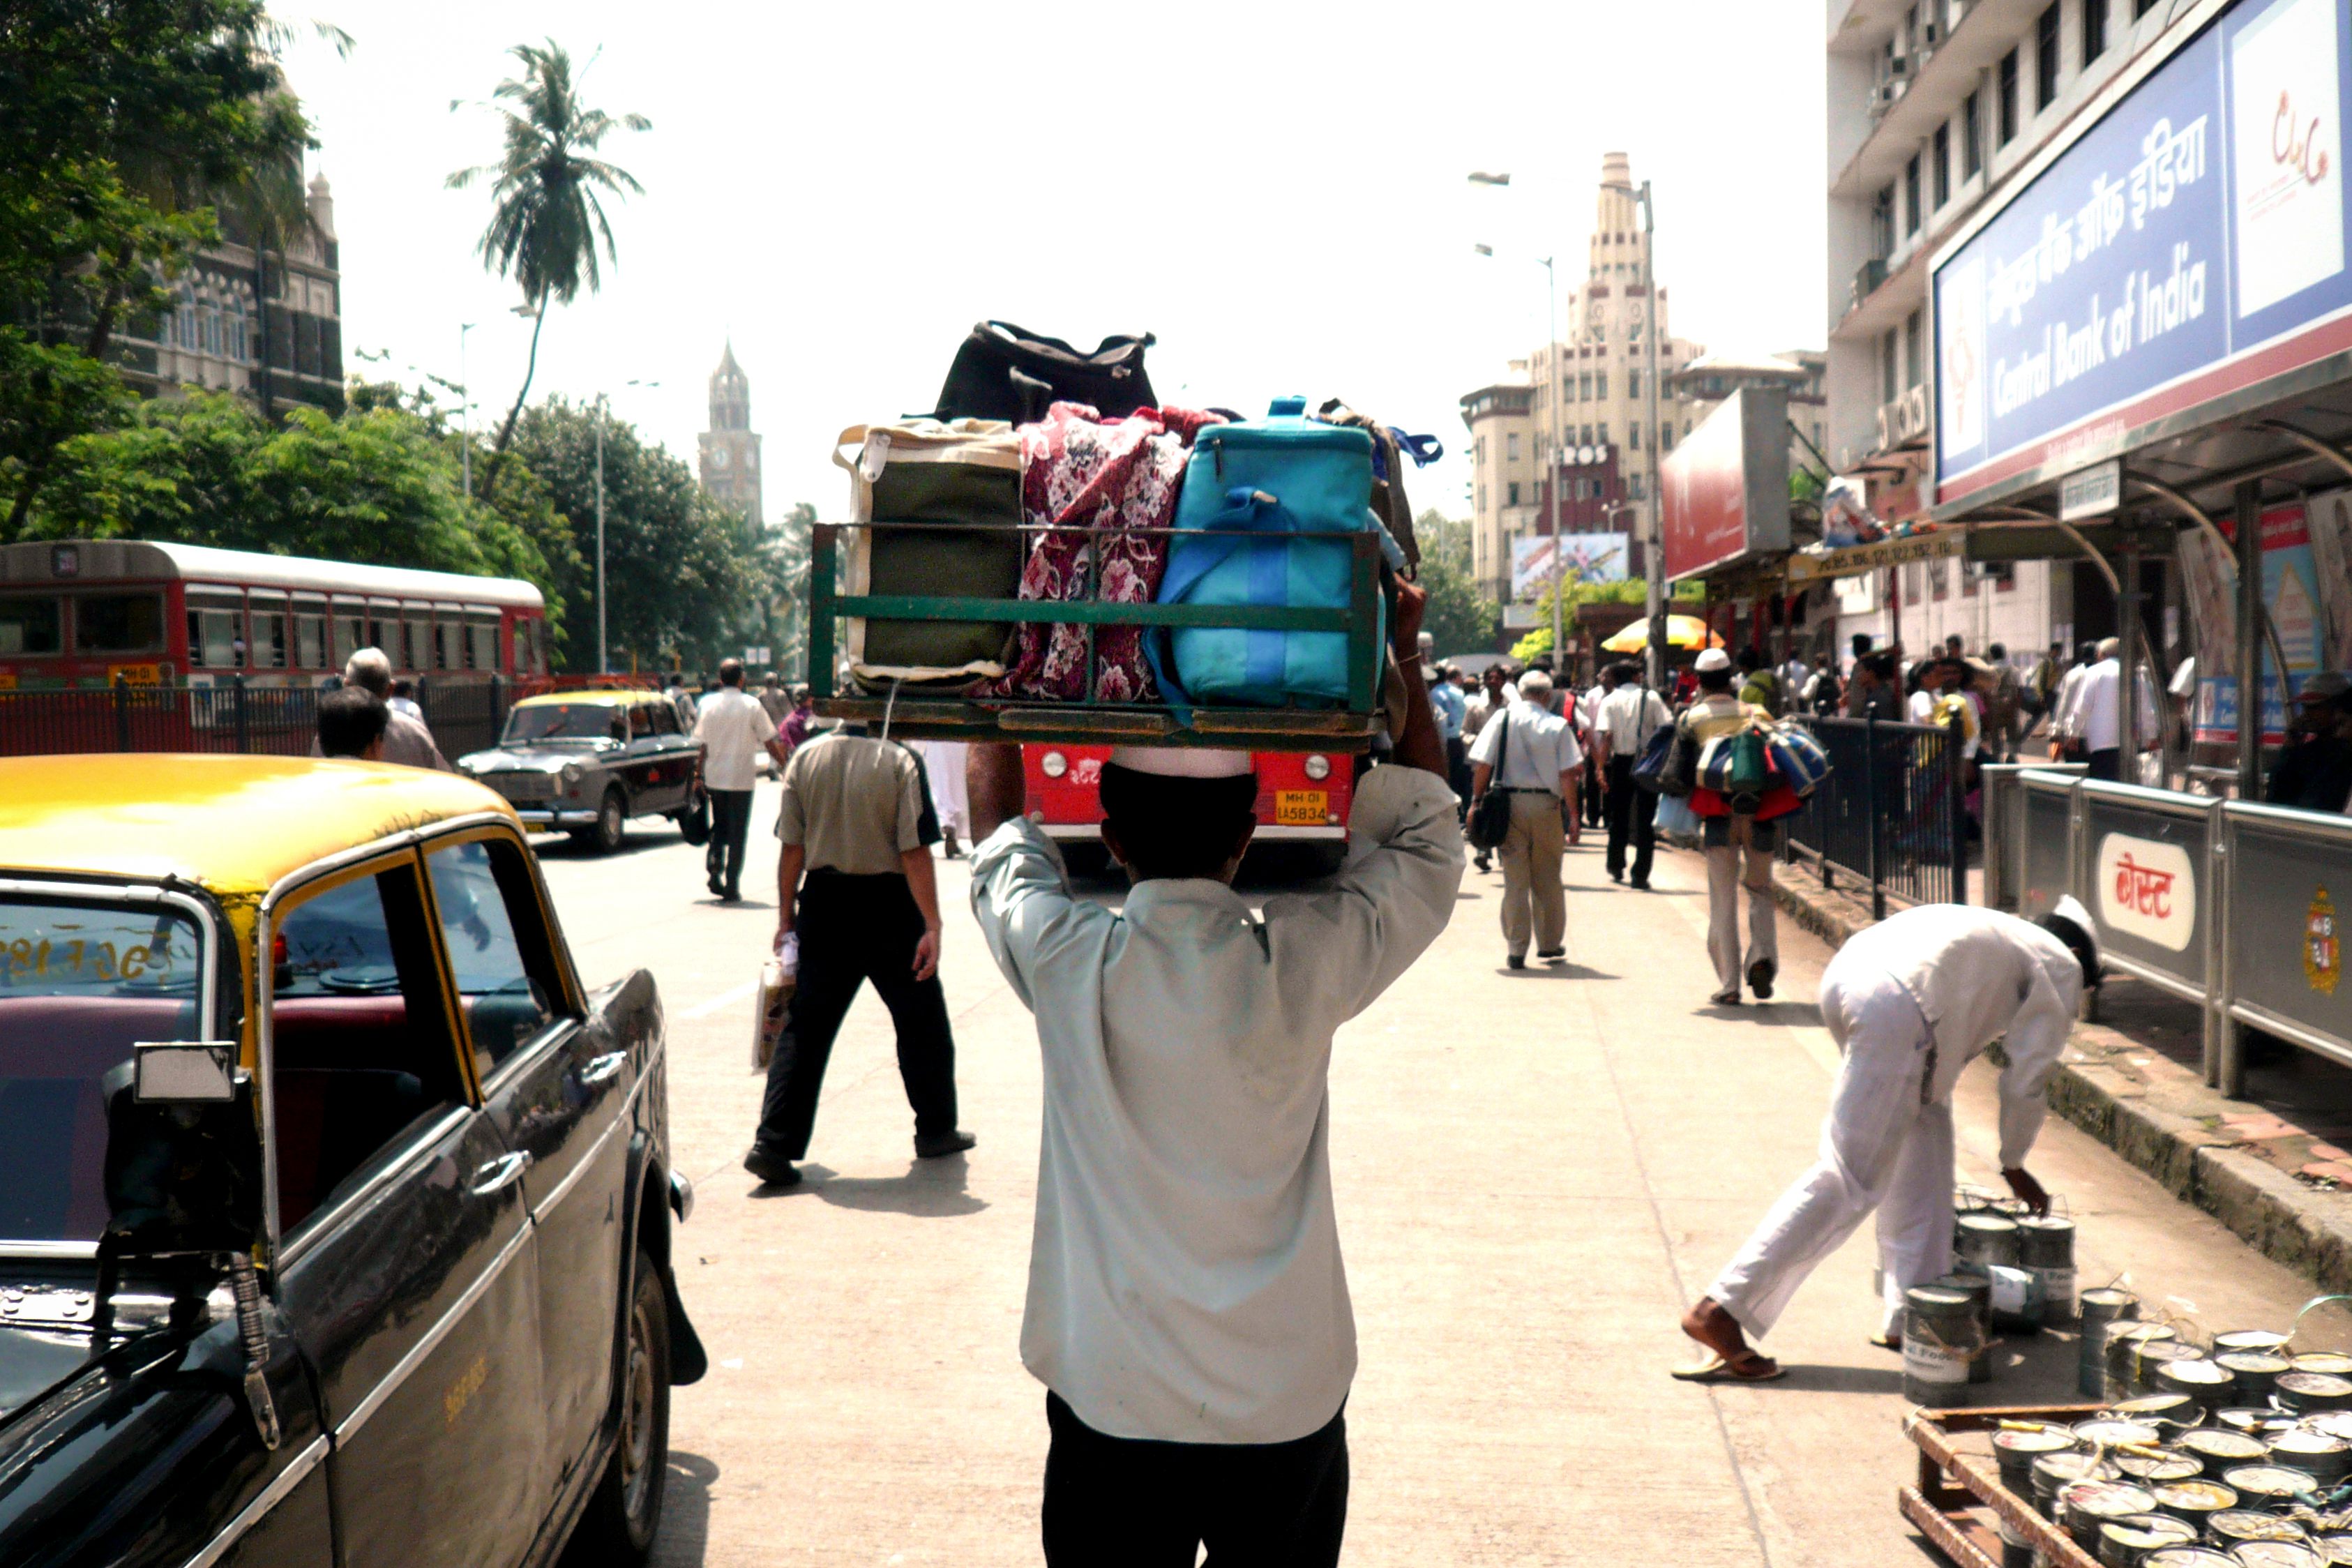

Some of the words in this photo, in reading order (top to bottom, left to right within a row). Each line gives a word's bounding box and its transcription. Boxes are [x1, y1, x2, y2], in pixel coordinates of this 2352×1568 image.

[1994, 323, 2051, 419] Central
[2055, 292, 2106, 388] Bank
[2110, 270, 2136, 358] of
[2141, 240, 2207, 345] India
[1286, 792, 1304, 803] MH
[2116, 852, 2176, 919] बेस्ट
